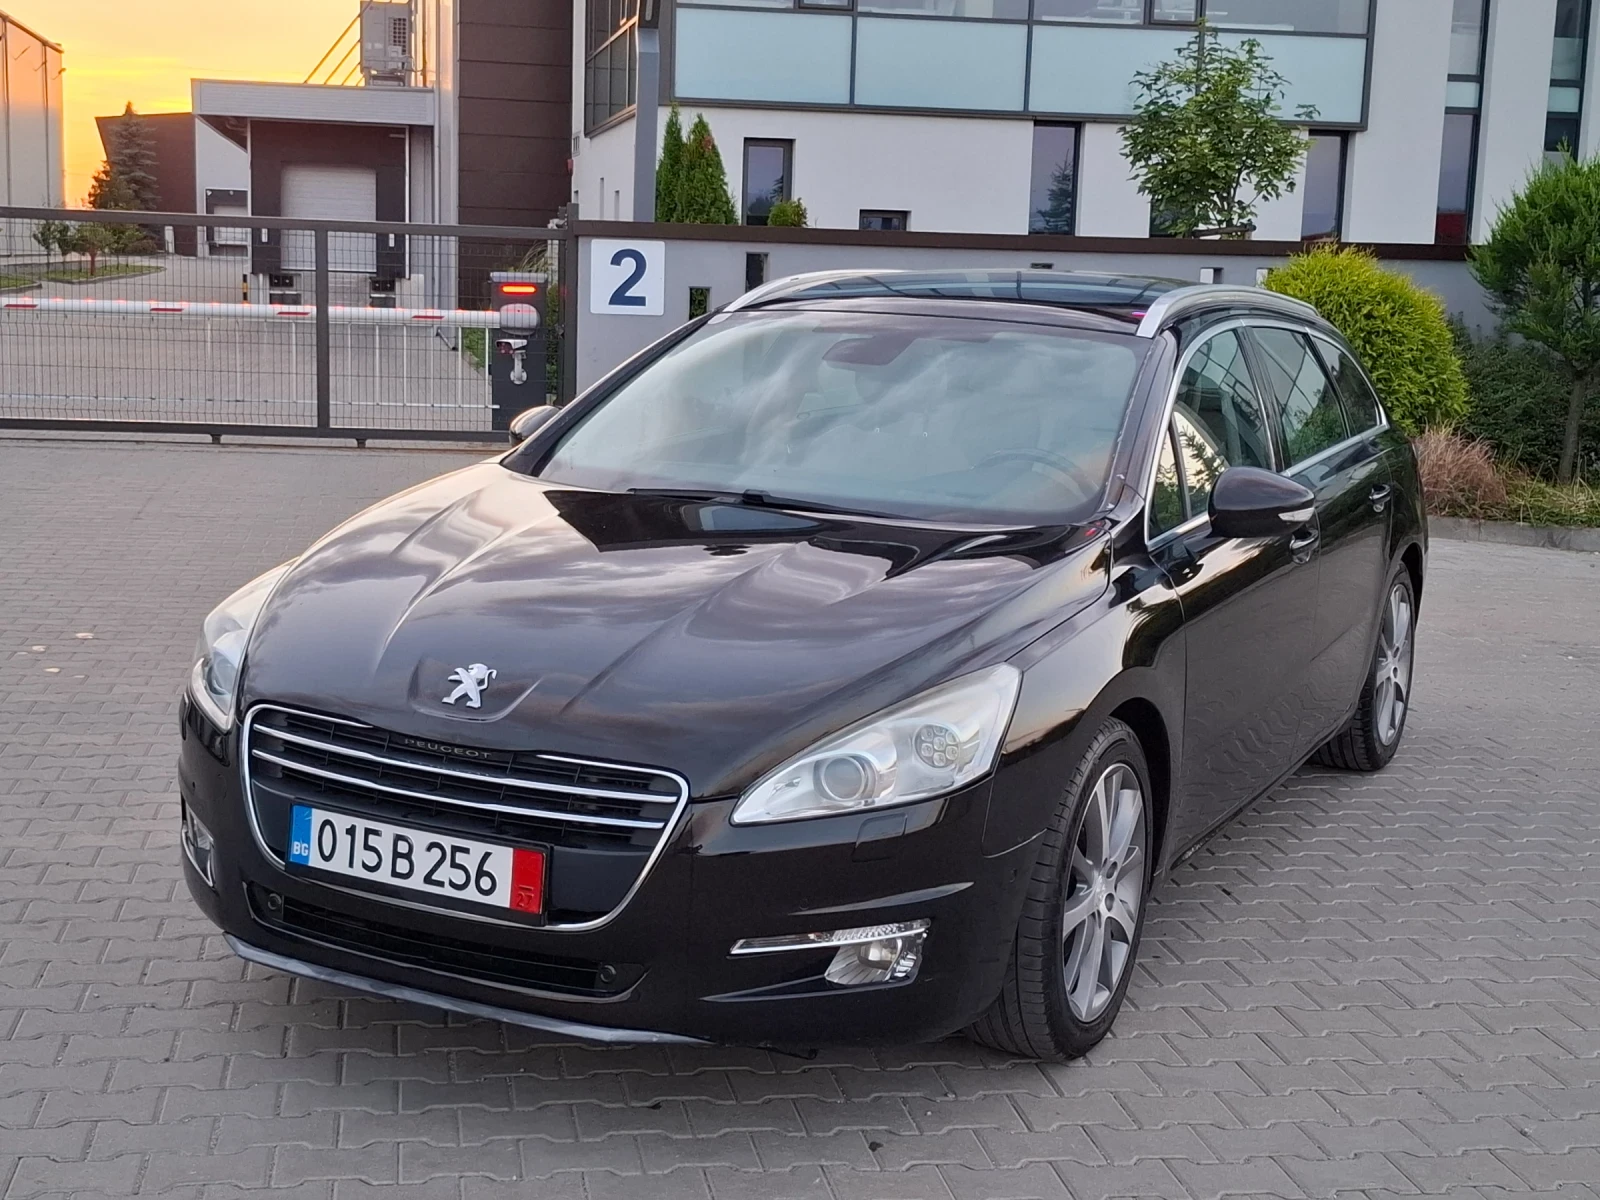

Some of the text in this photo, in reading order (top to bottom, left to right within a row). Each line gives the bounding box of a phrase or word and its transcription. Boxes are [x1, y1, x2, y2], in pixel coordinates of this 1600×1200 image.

[608, 248, 647, 306] 2
[404, 738, 492, 759] PEUGEOT
[293, 841, 309, 856] BG
